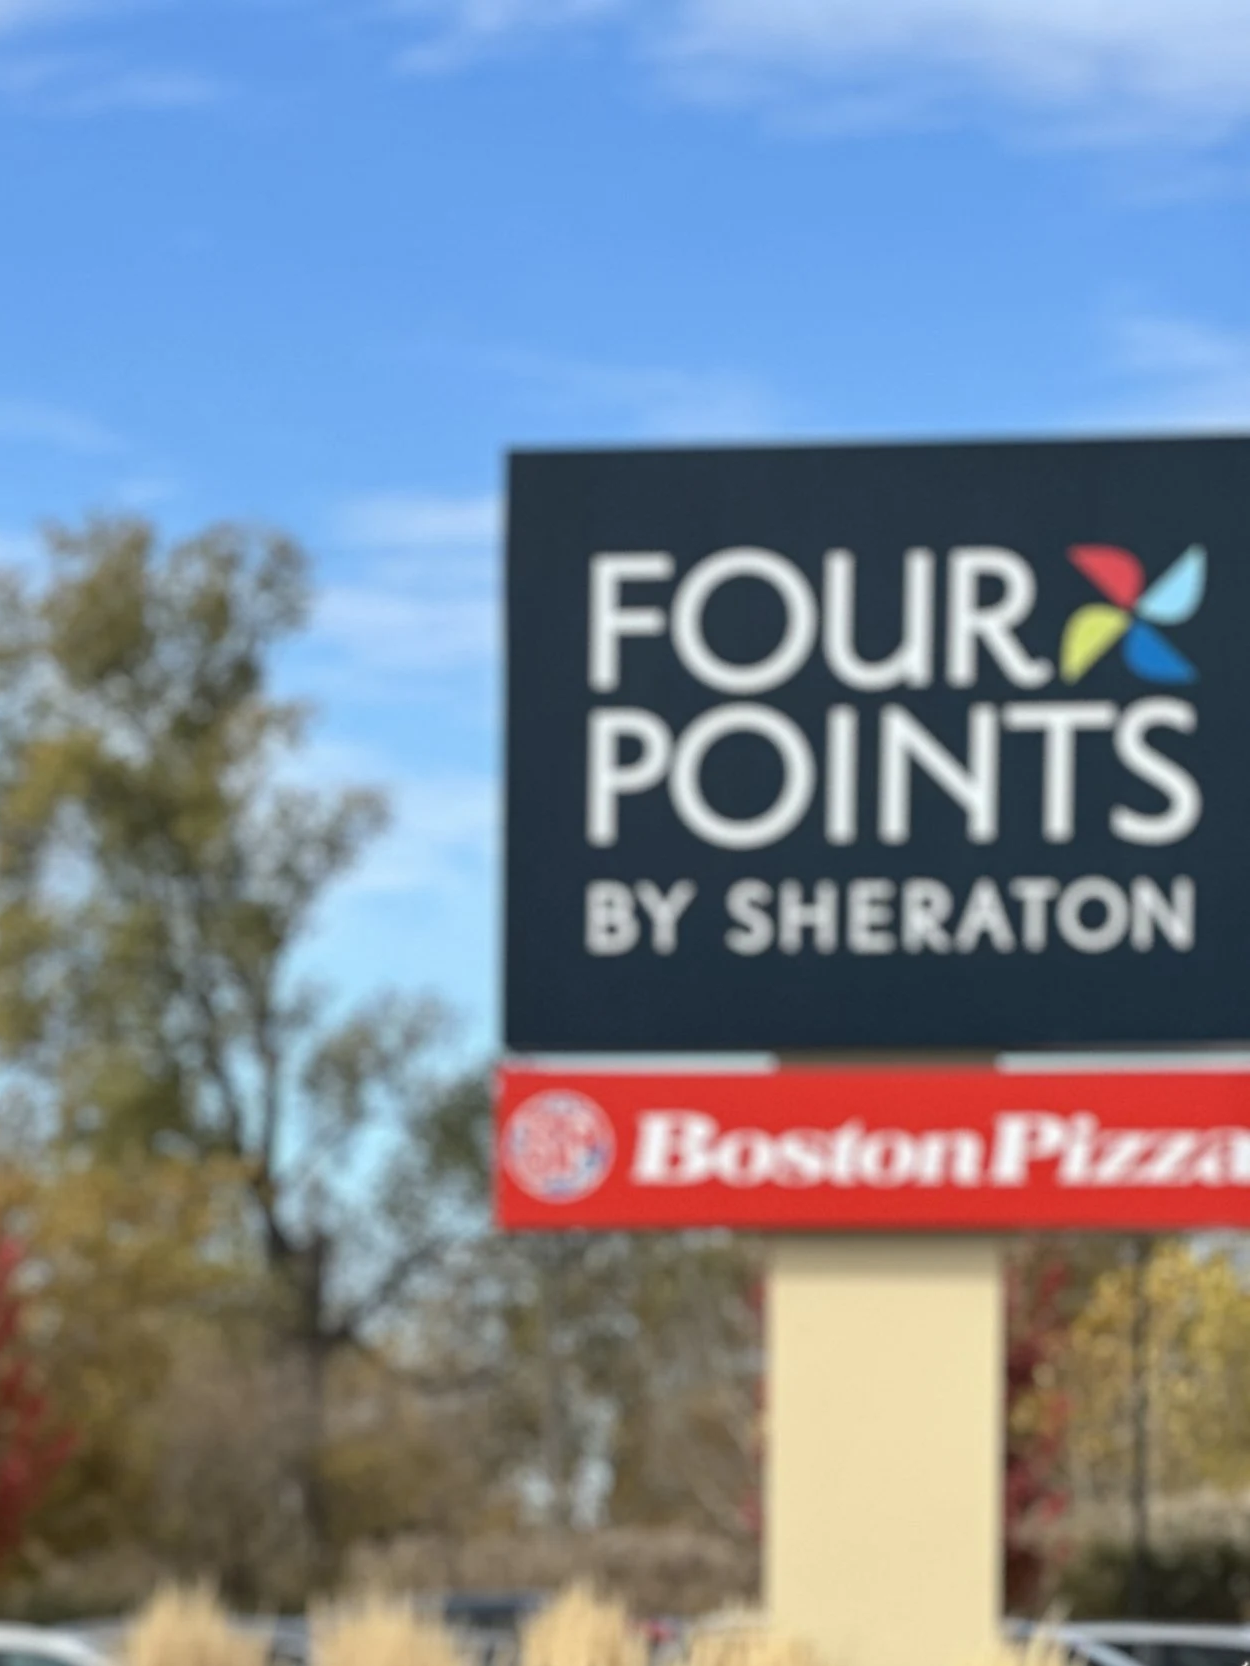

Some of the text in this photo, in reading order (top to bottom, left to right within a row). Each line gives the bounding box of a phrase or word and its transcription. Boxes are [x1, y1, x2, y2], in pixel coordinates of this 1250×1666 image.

[589, 545, 1053, 694] FOUR
[587, 695, 1203, 849] POINTS
[585, 875, 1196, 955] BY SHERATON
[632, 1110, 983, 1188] Boston
